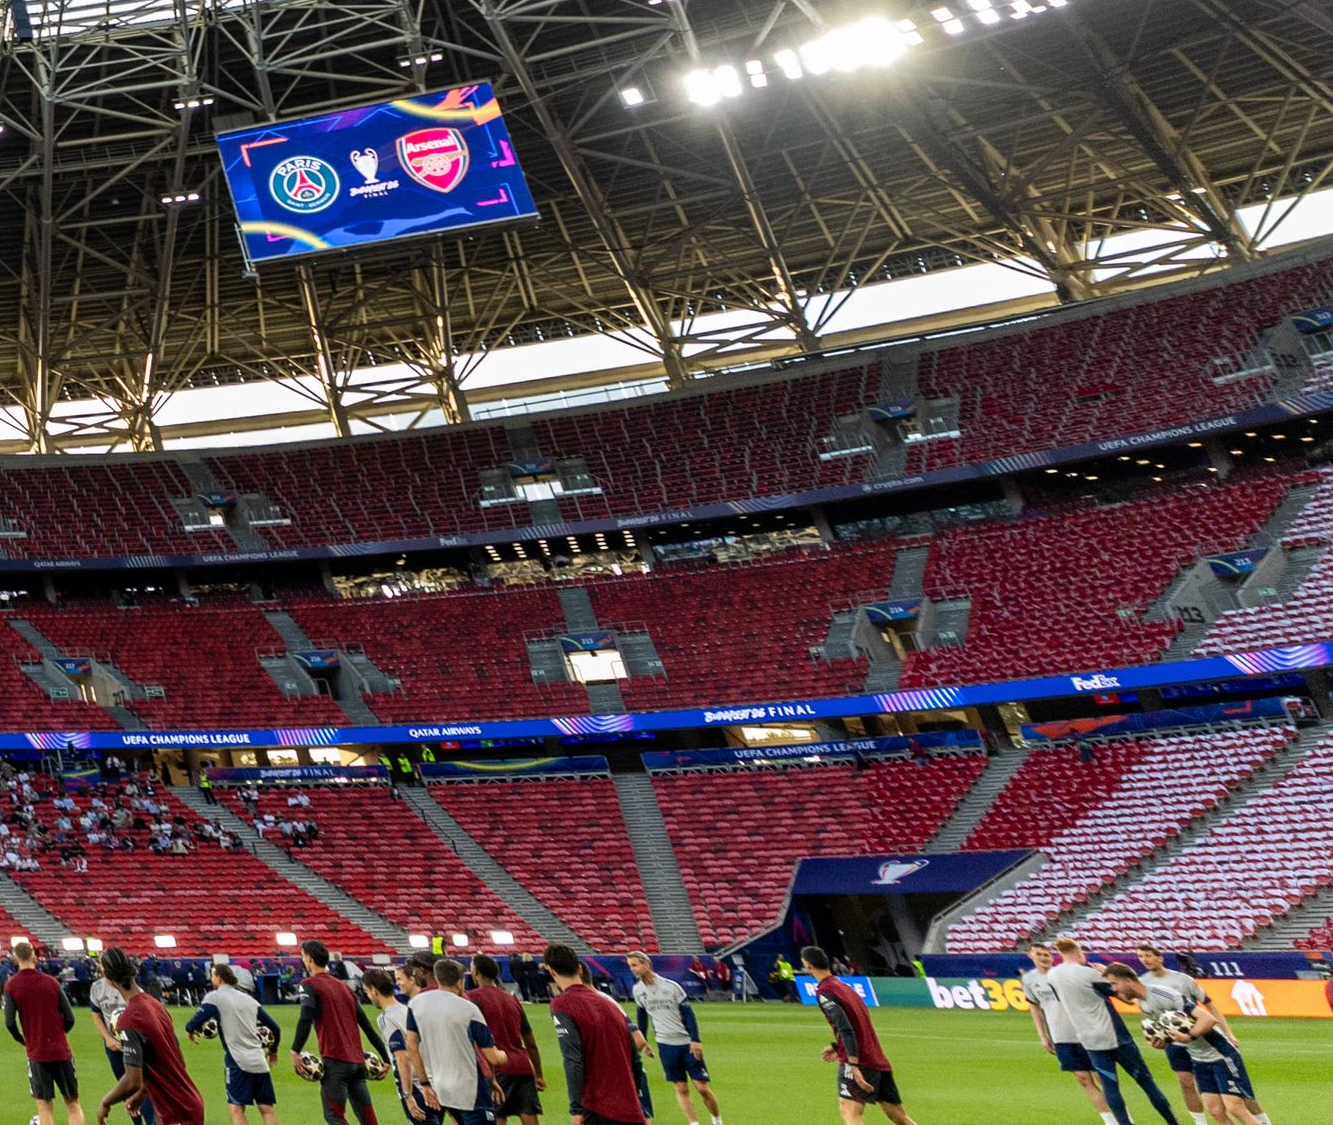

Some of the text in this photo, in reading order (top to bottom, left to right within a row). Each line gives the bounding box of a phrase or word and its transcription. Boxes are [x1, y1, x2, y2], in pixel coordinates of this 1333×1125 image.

[406, 134, 455, 153] Arsenal
[277, 158, 322, 177] PARIS
[1099, 415, 1237, 451] UEFA CHAMPIONS LEAGUE
[873, 476, 923, 491] crypto.com
[661, 511, 694, 521] FINAL
[203, 550, 299, 563] UEFA CHAMPIONS LEAGUE
[1071, 673, 1121, 691] FedEx
[768, 704, 816, 716] FINAL
[122, 733, 251, 745] UEFA CHAMPIONS LEAGUE
[409, 726, 482, 738] QATAR AIRWAYS
[734, 747, 763, 758] UEFA
[766, 744, 830, 756] CHAMPIONS
[303, 768, 334, 777] FINAL
[1209, 961, 1244, 976] 111
[925, 976, 1031, 1012] bet36
